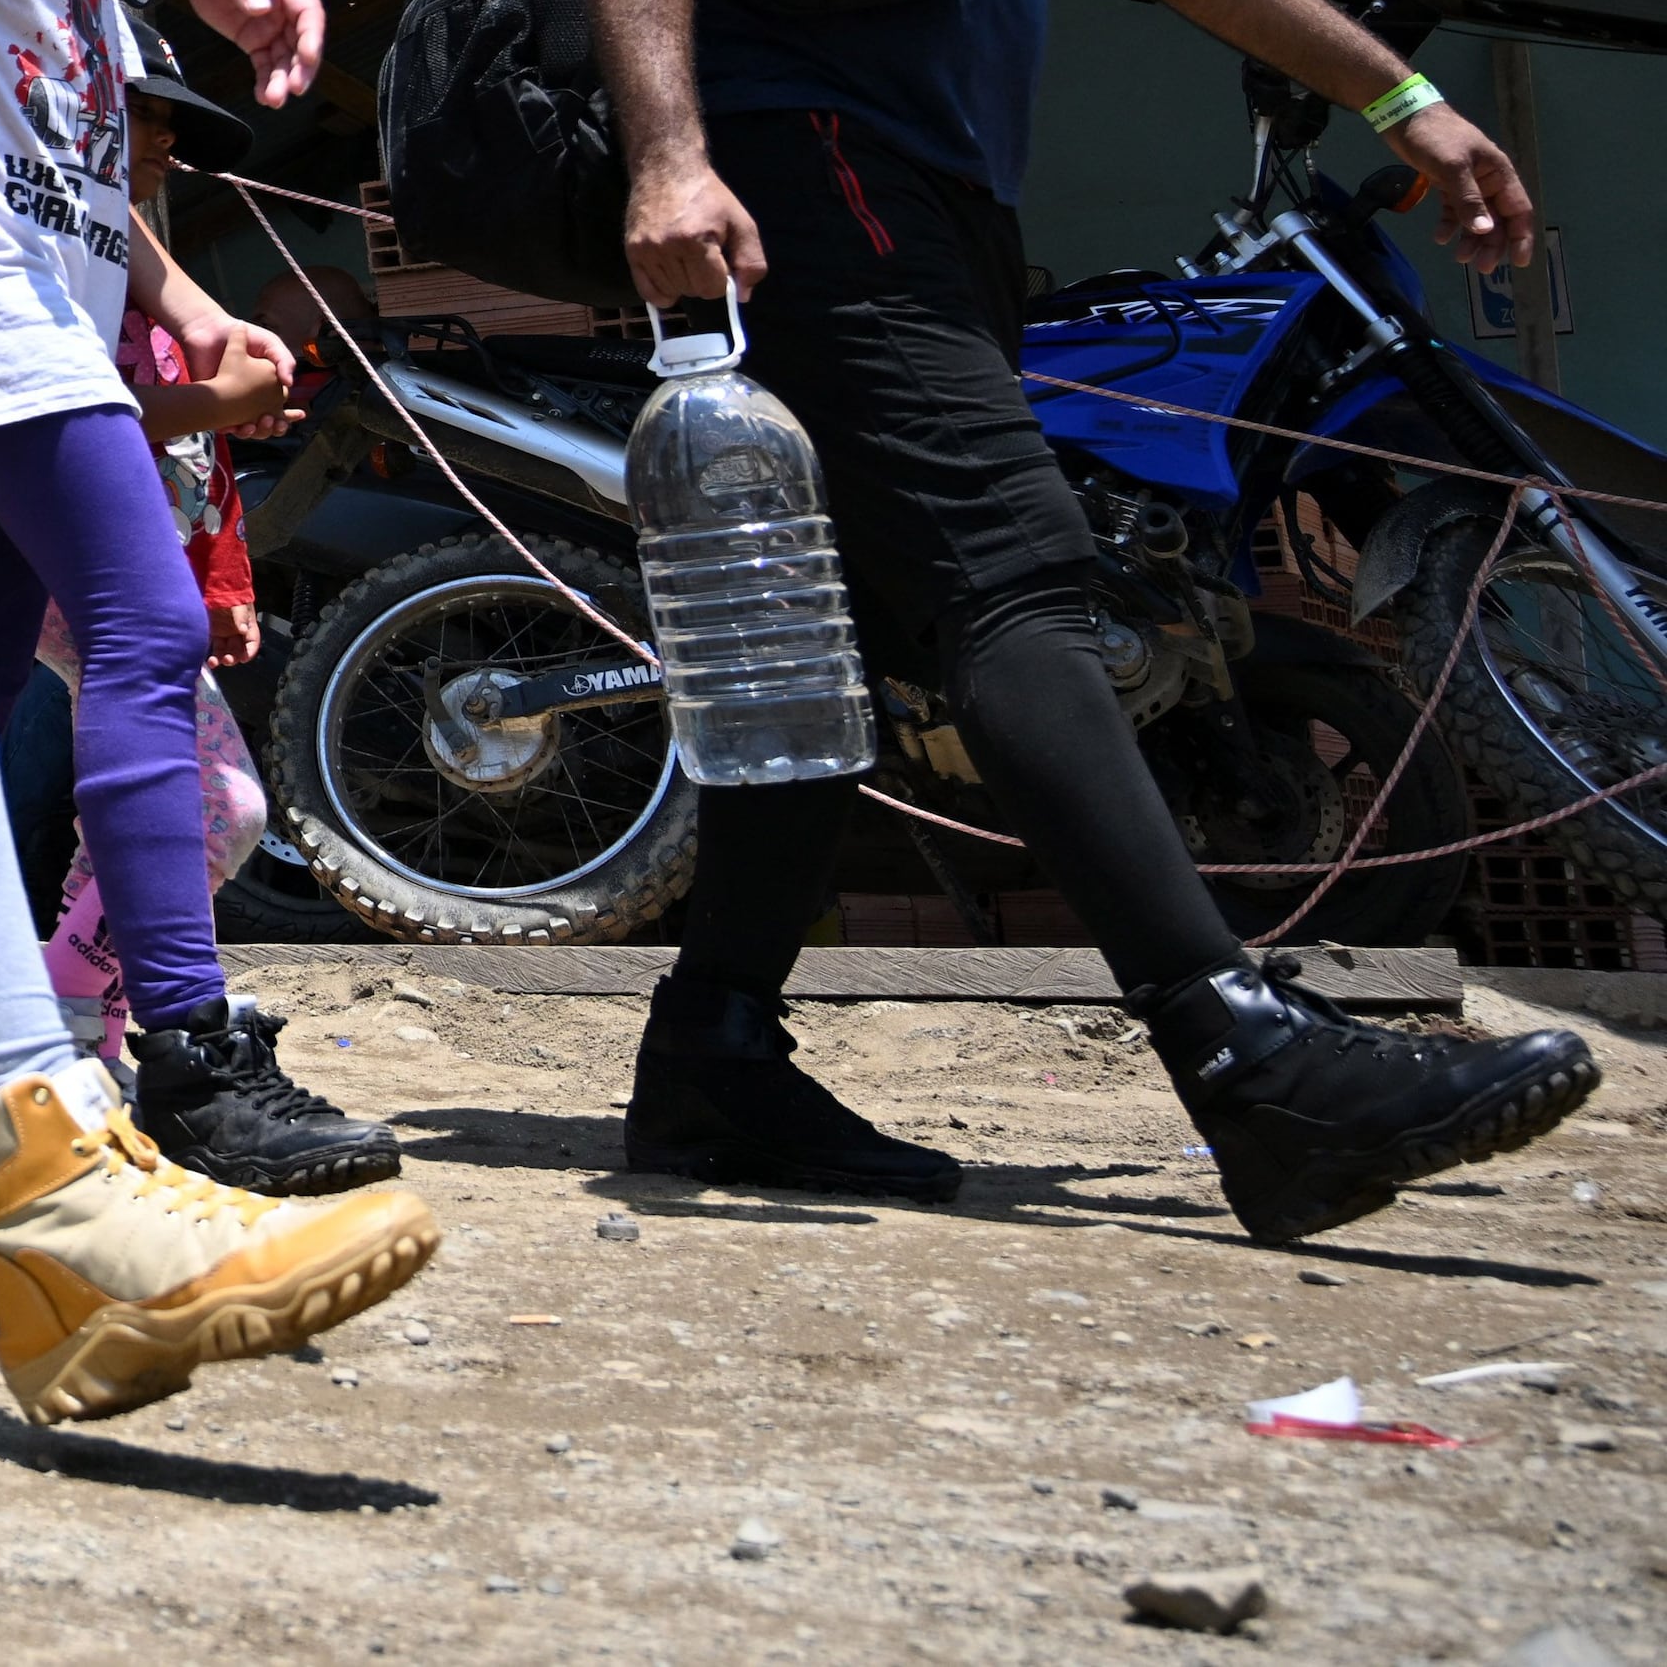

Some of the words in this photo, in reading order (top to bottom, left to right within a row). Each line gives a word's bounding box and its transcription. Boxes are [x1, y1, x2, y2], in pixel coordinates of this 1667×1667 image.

[587, 664, 662, 692] YAMA
[68, 933, 119, 975] adidas
[101, 1002, 127, 1019] das
